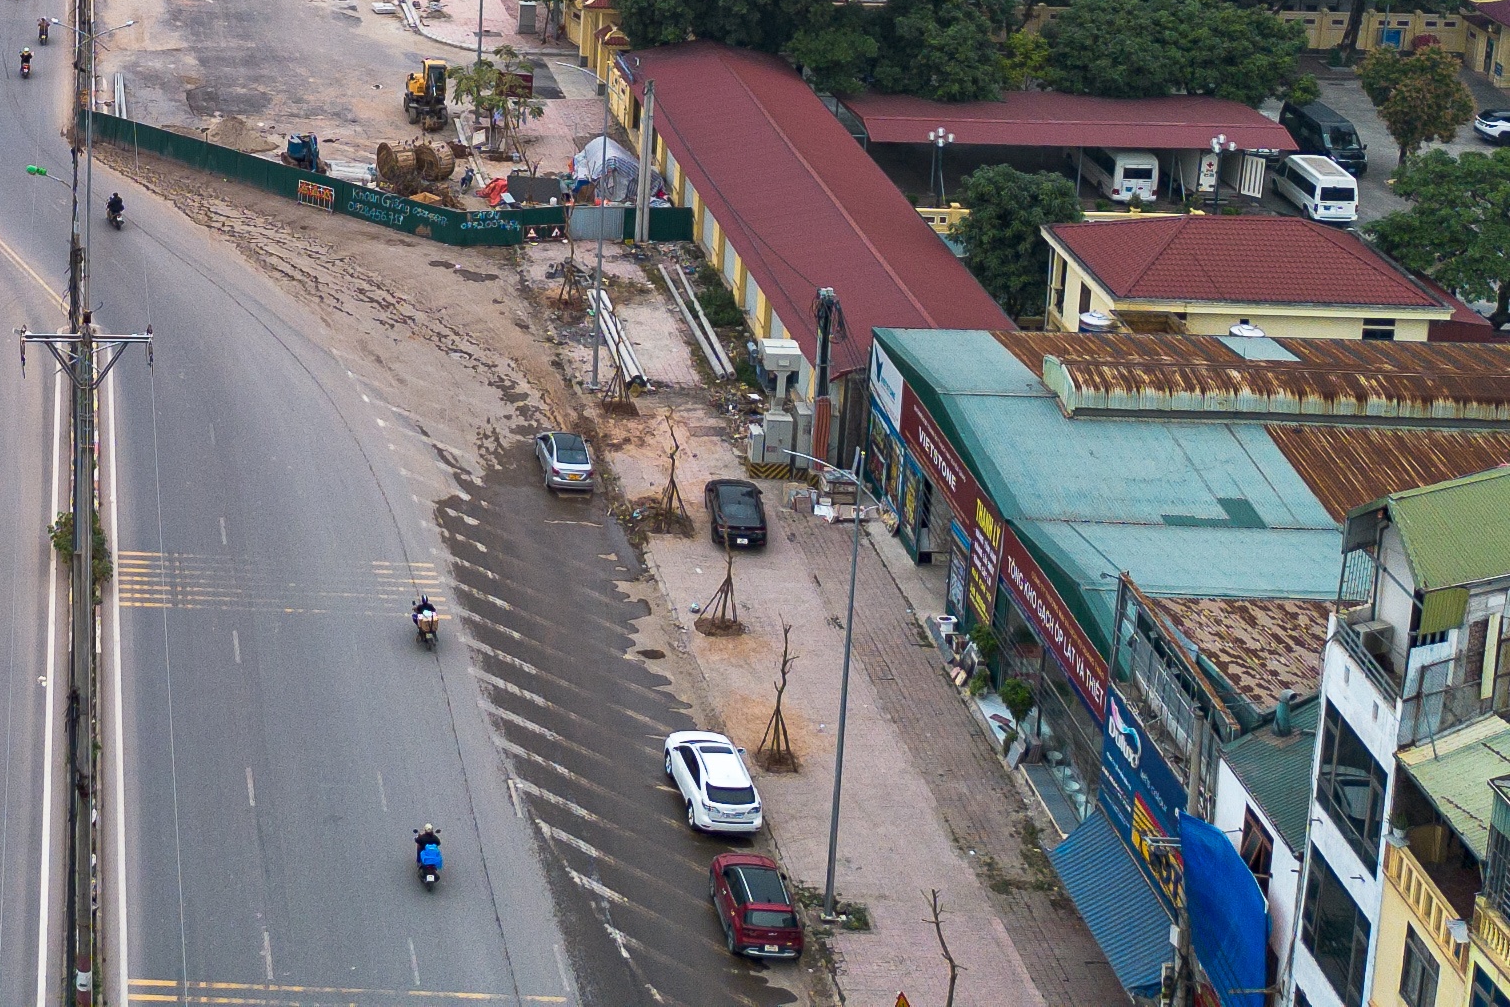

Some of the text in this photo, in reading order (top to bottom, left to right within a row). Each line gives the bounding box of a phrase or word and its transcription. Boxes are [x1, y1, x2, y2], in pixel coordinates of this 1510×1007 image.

[918, 425, 957, 493] VIETSTONE
[976, 497, 994, 540] THANH
[1007, 554, 1104, 706] TỔNG KHO GẠCH ỐP LÁT VÀ THIẾT
[1108, 715, 1140, 769] Dulux
